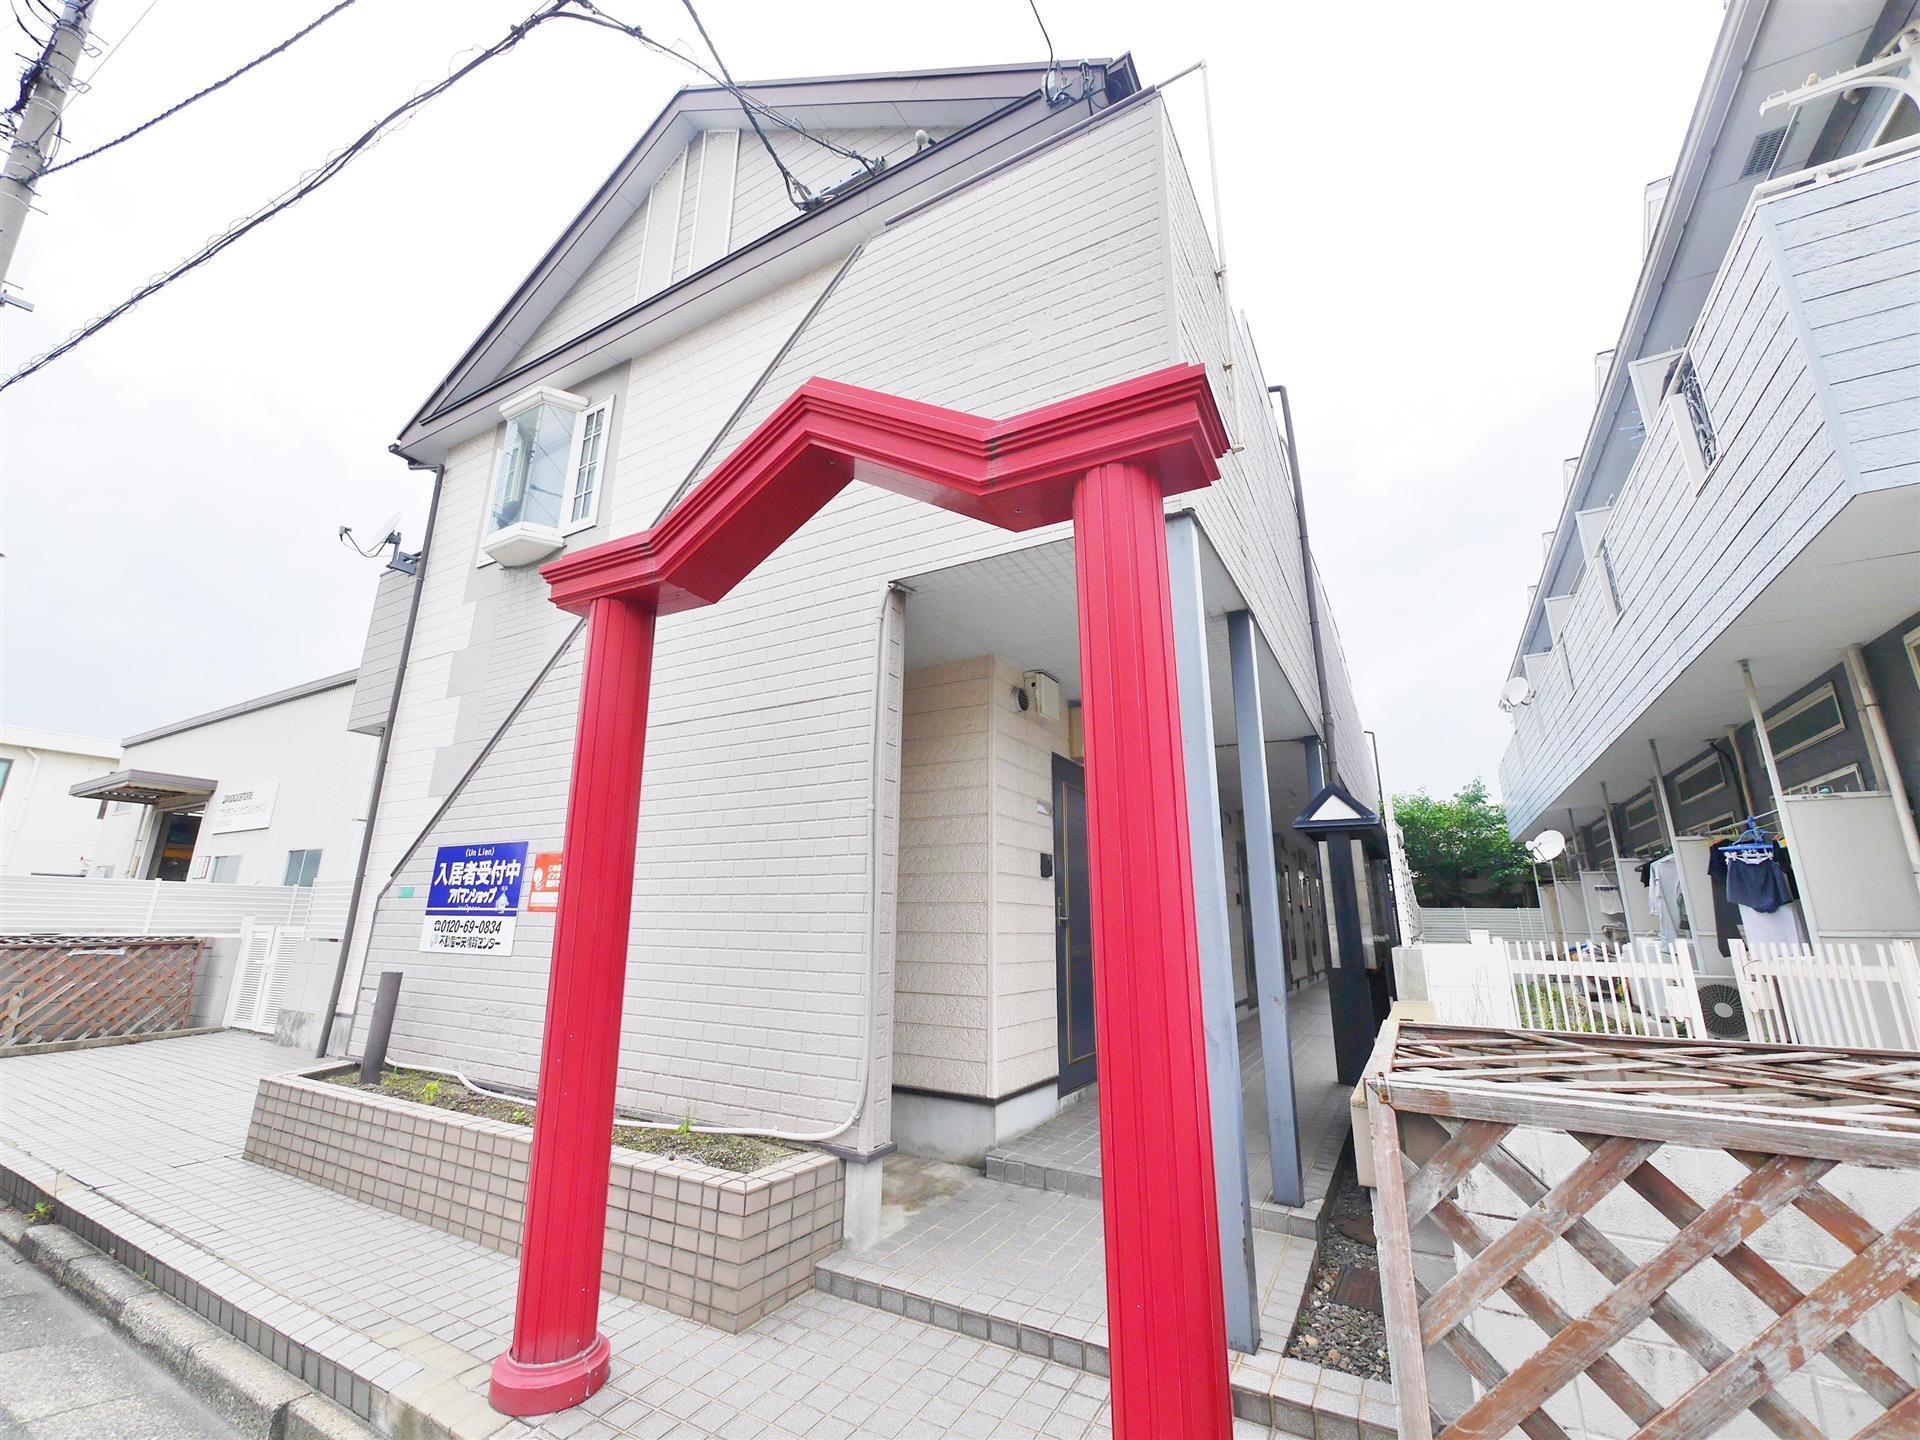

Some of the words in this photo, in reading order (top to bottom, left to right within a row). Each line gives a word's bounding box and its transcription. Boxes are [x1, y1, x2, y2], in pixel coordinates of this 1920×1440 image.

[434, 858, 521, 886] 入居者受付中
[440, 919, 502, 934] 0120-69-0834
